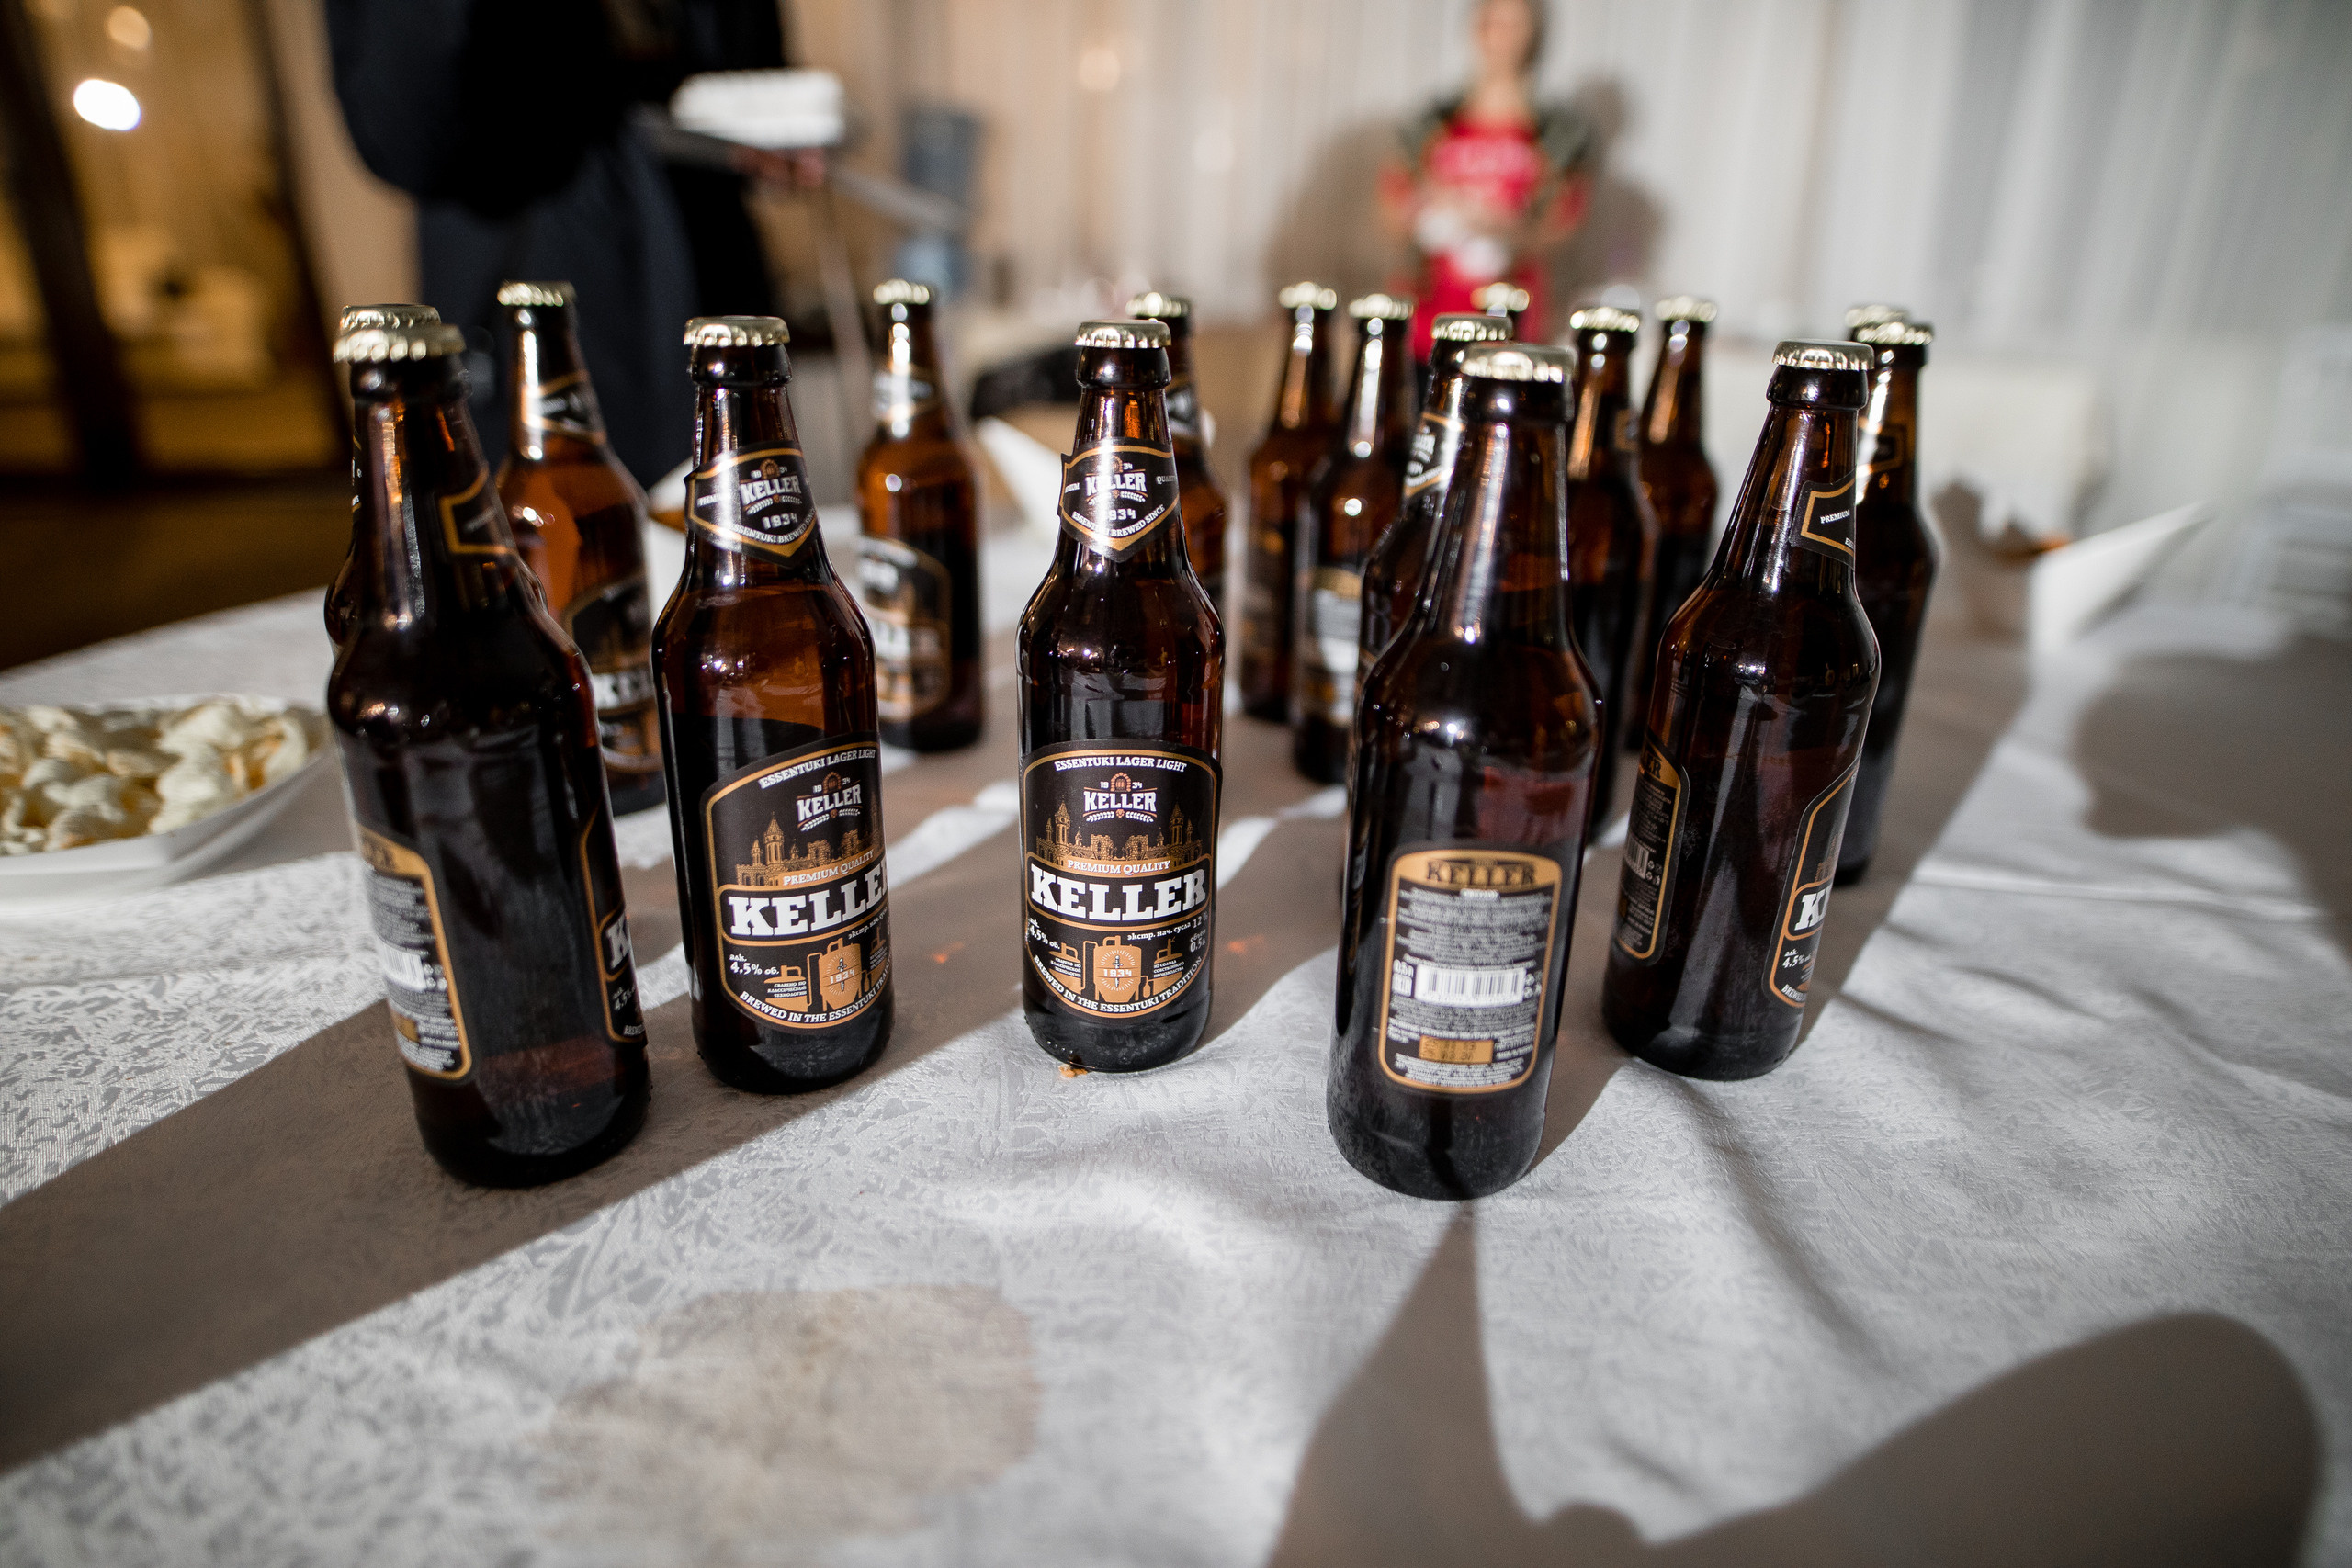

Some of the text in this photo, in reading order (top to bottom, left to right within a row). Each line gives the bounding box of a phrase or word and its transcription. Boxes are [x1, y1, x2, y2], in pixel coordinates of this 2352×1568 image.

[739, 475, 802, 505] KELLER
[1085, 472, 1147, 496] KLLER
[1156, 475, 1177, 485] QUALIT
[762, 513, 798, 530] 1934
[1071, 504, 1165, 537] ESSENTI BREWED SINCE
[1105, 508, 1136, 521] 934
[1820, 509, 1850, 524] PREMIUM
[778, 524, 807, 544] BREWED
[758, 749, 876, 789] ESSENTUKI LAGER LIGHT
[1055, 756, 1187, 772] ESSENTUKI LAGER LIGHT
[813, 784, 822, 793] 19
[797, 784, 862, 822] KELLER
[1083, 791, 1157, 812] KELLER
[783, 851, 874, 886] PREMIUM QUALITY
[1068, 860, 1171, 875] PREMIUM QUALITY
[1031, 863, 1206, 922] KELLER
[830, 969, 855, 984] 1934
[1103, 968, 1132, 977] 1934
[1033, 954, 1202, 1012] BREWED IN THE ESSENTUKI TRADITION
[740, 991, 787, 1019] BREWED
[788, 1012, 802, 1022] IN
[804, 1013, 827, 1022] THE
[829, 987, 876, 1021] ESSENTUKI
